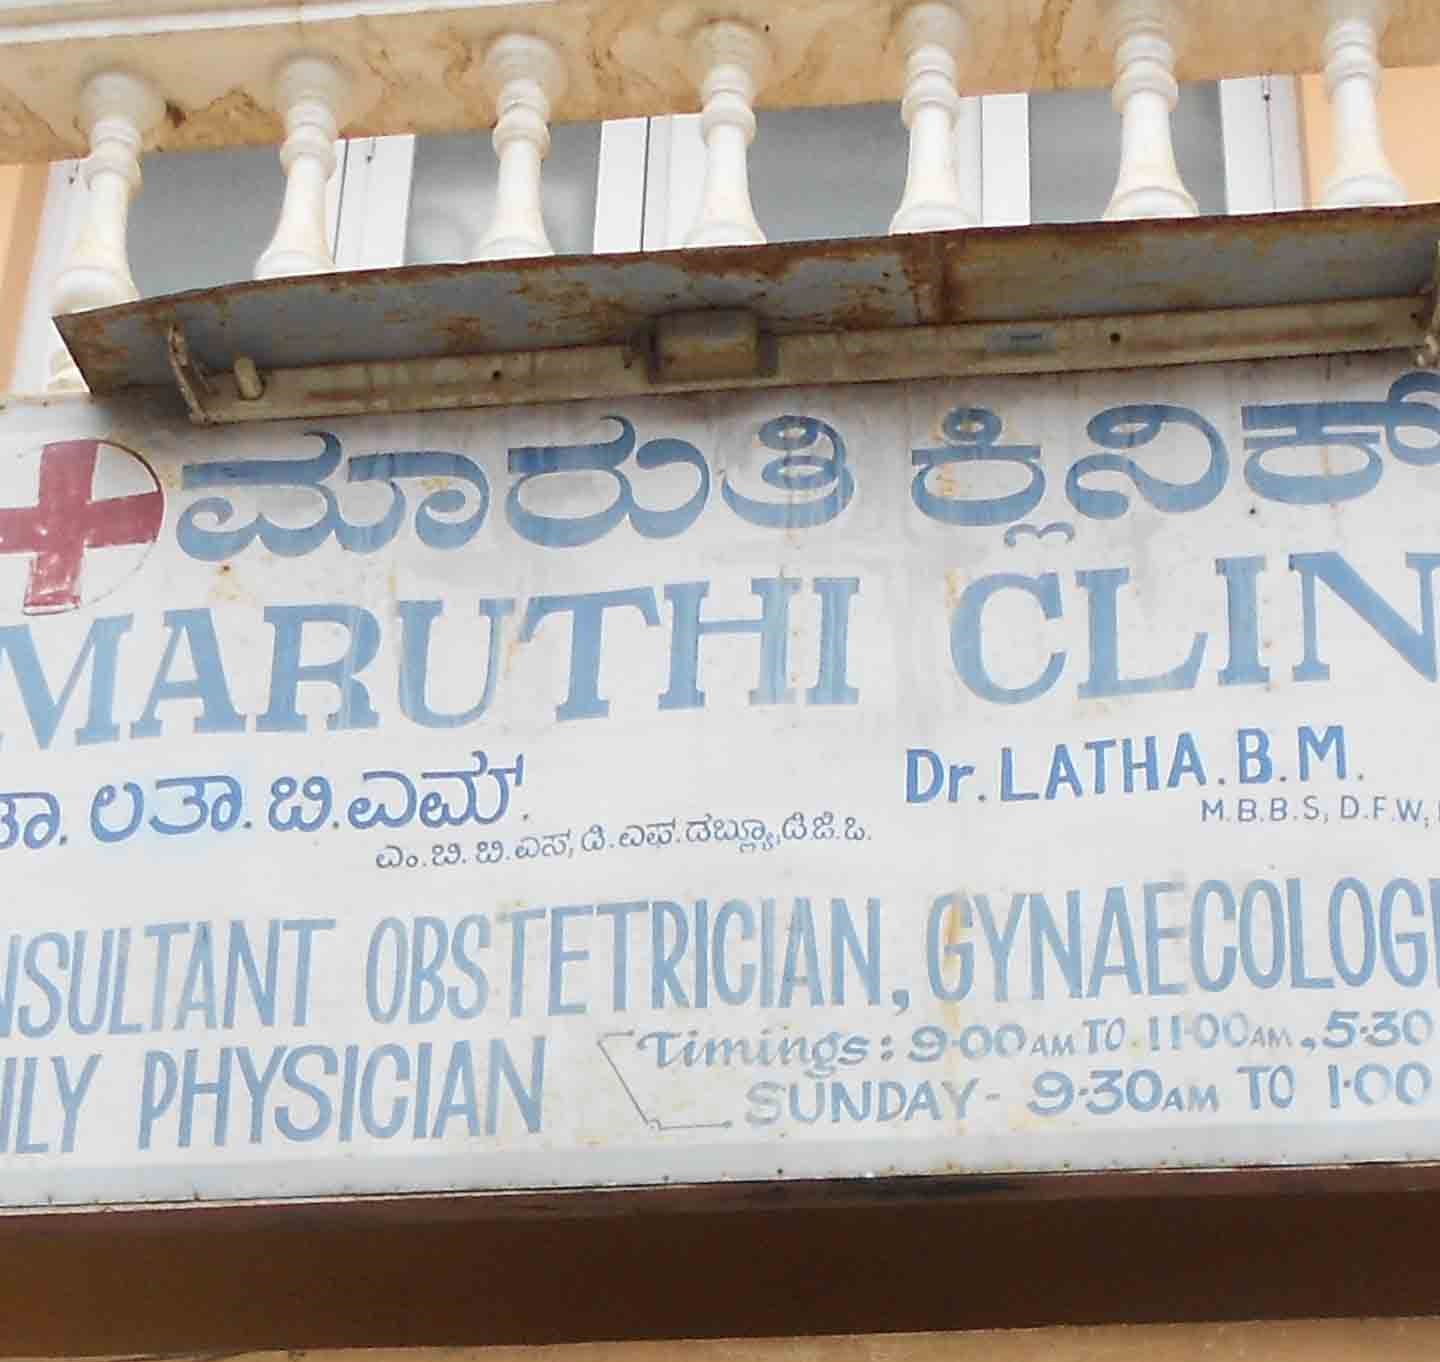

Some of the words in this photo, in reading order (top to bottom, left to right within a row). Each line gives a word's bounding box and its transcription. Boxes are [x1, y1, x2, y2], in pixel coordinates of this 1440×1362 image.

[175, 412, 857, 563] ಮಾರುತಿ
[365, 892, 910, 1025] OBSTETRICIAN,
[137, 1036, 547, 1151] PHYSICIAN
[1082, 1017, 1126, 1055] TO
[1236, 1063, 1296, 1110] TO
